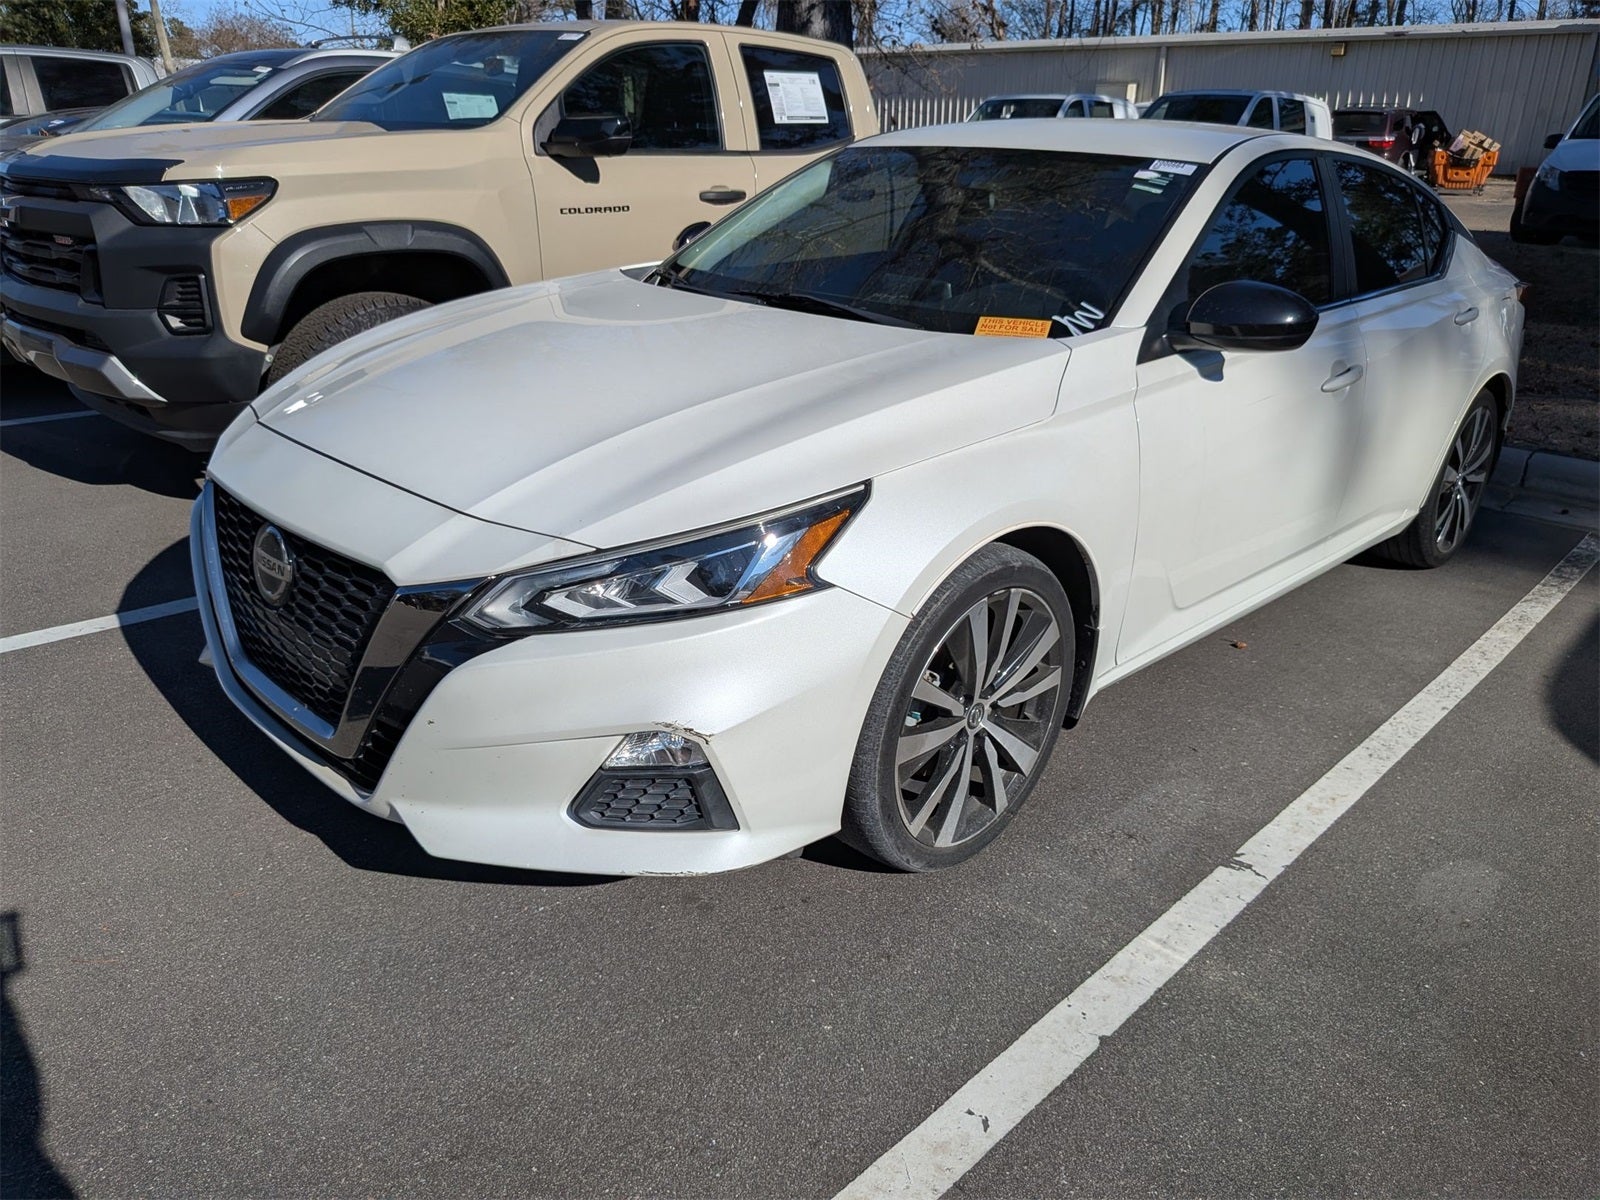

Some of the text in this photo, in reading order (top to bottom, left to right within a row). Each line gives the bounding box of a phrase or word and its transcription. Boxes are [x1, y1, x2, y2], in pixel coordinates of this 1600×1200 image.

[560, 205, 630, 215] COLORADO
[1007, 319, 1048, 328] VEHICLE
[1021, 326, 1047, 334] SALE
[257, 552, 285, 577] SSAN
